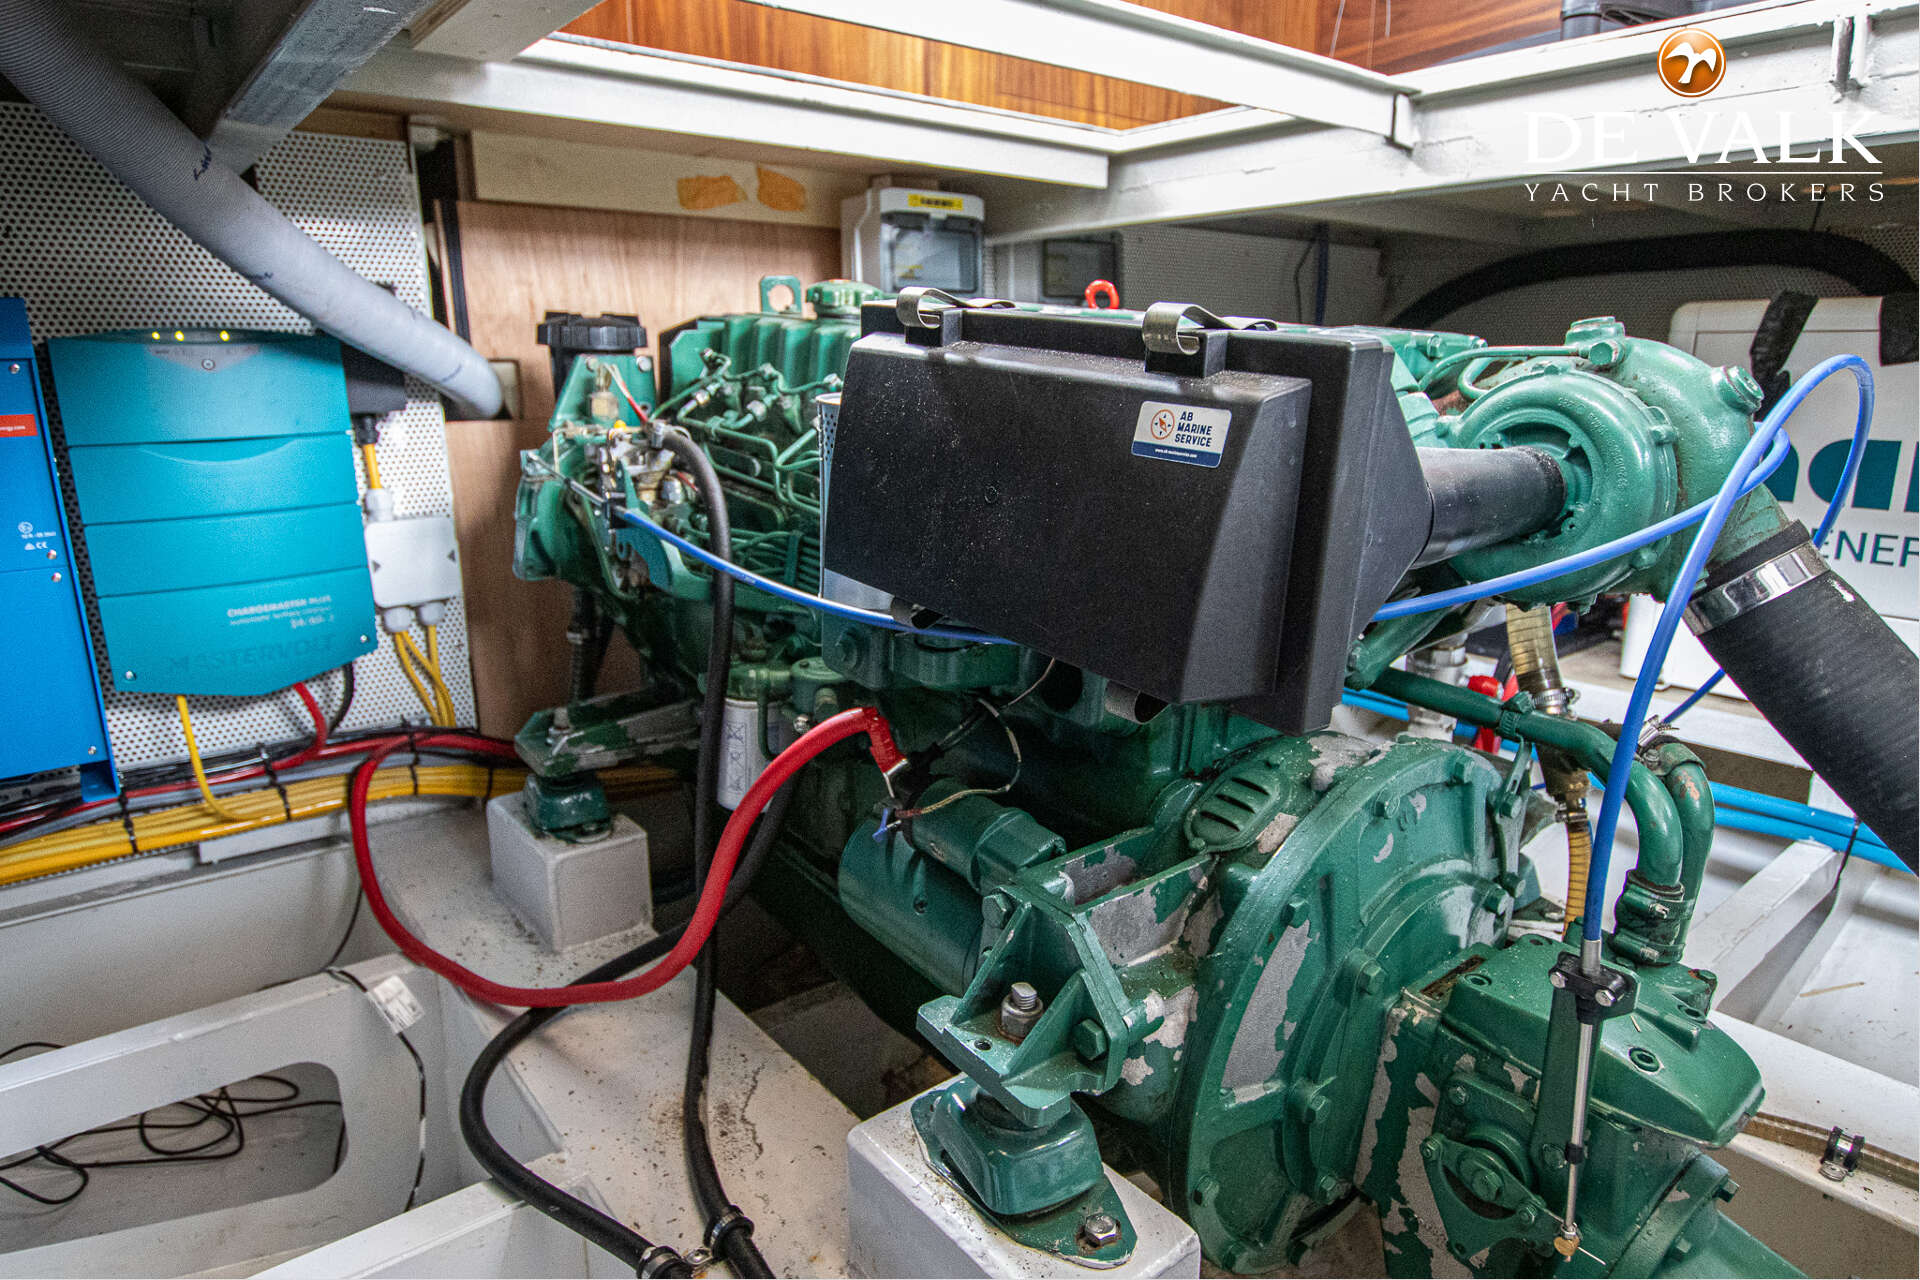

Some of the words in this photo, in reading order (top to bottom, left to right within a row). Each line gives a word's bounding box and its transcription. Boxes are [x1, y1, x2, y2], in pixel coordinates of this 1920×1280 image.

[1180, 411, 1193, 421] AB
[1177, 422, 1212, 435] MARINE
[1175, 434, 1212, 447] SERVICE
